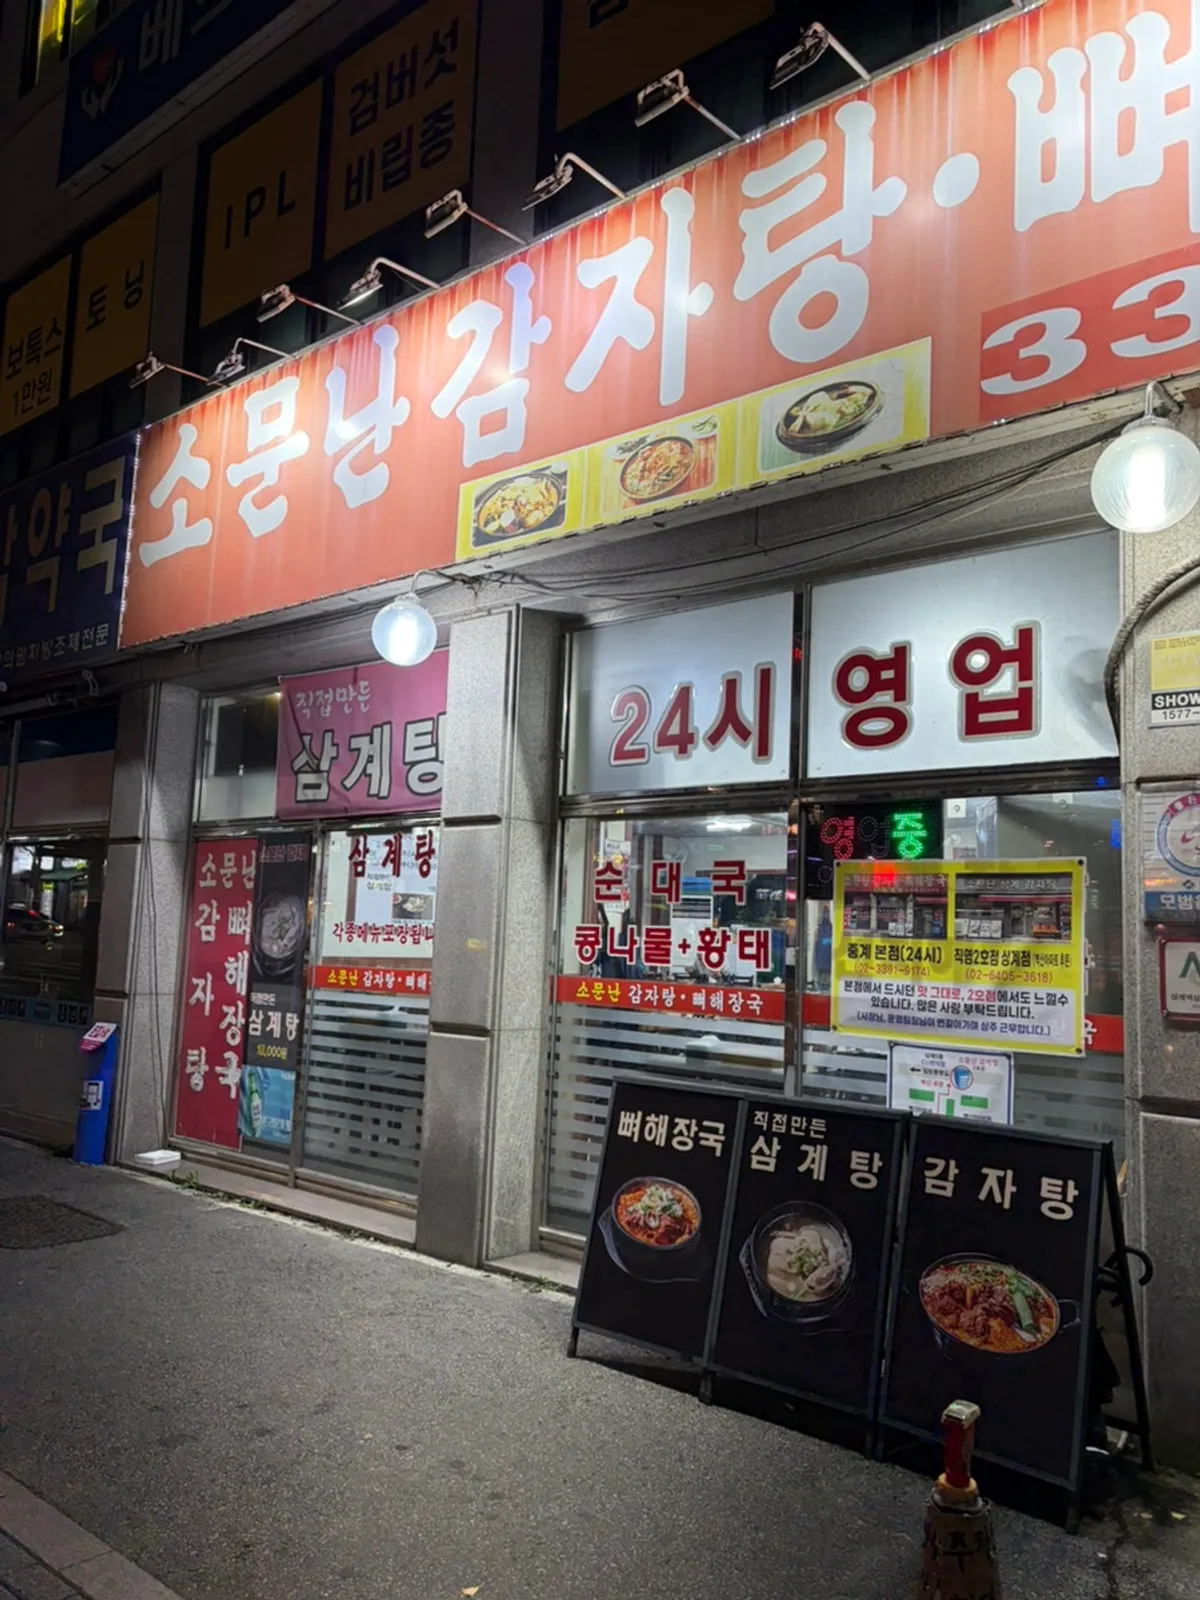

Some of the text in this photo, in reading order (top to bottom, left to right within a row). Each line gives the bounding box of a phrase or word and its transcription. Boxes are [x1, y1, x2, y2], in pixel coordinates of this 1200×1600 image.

[349, 17, 459, 136] 검버섯
[344, 100, 457, 212] 비립종
[224, 169, 297, 249] IPL
[6, 320, 63, 381] 보톡스
[13, 370, 54, 418] 1만원
[139, 325, 412, 568] 소문난
[296, 680, 371, 719] 직접만든
[610, 621, 1041, 766] 24시 영업
[199, 849, 258, 890] 소문난
[348, 830, 436, 878] 삼계탕
[593, 859, 747, 906] 순대국
[185, 899, 221, 1093] 감자탕
[576, 981, 621, 1003] 소문난
[870, 996, 914, 1011] 있습니다.
[940, 1001, 961, 1015] 사랑
[883, 982, 915, 997] 드시던
[248, 1009, 300, 1042] 삼계탕
[617, 1110, 727, 1158] 뼈해장국
[753, 1110, 828, 1139] 직접만든
[750, 1135, 884, 1190] 삼계탕
[923, 1157, 1080, 1221] 감자탕
